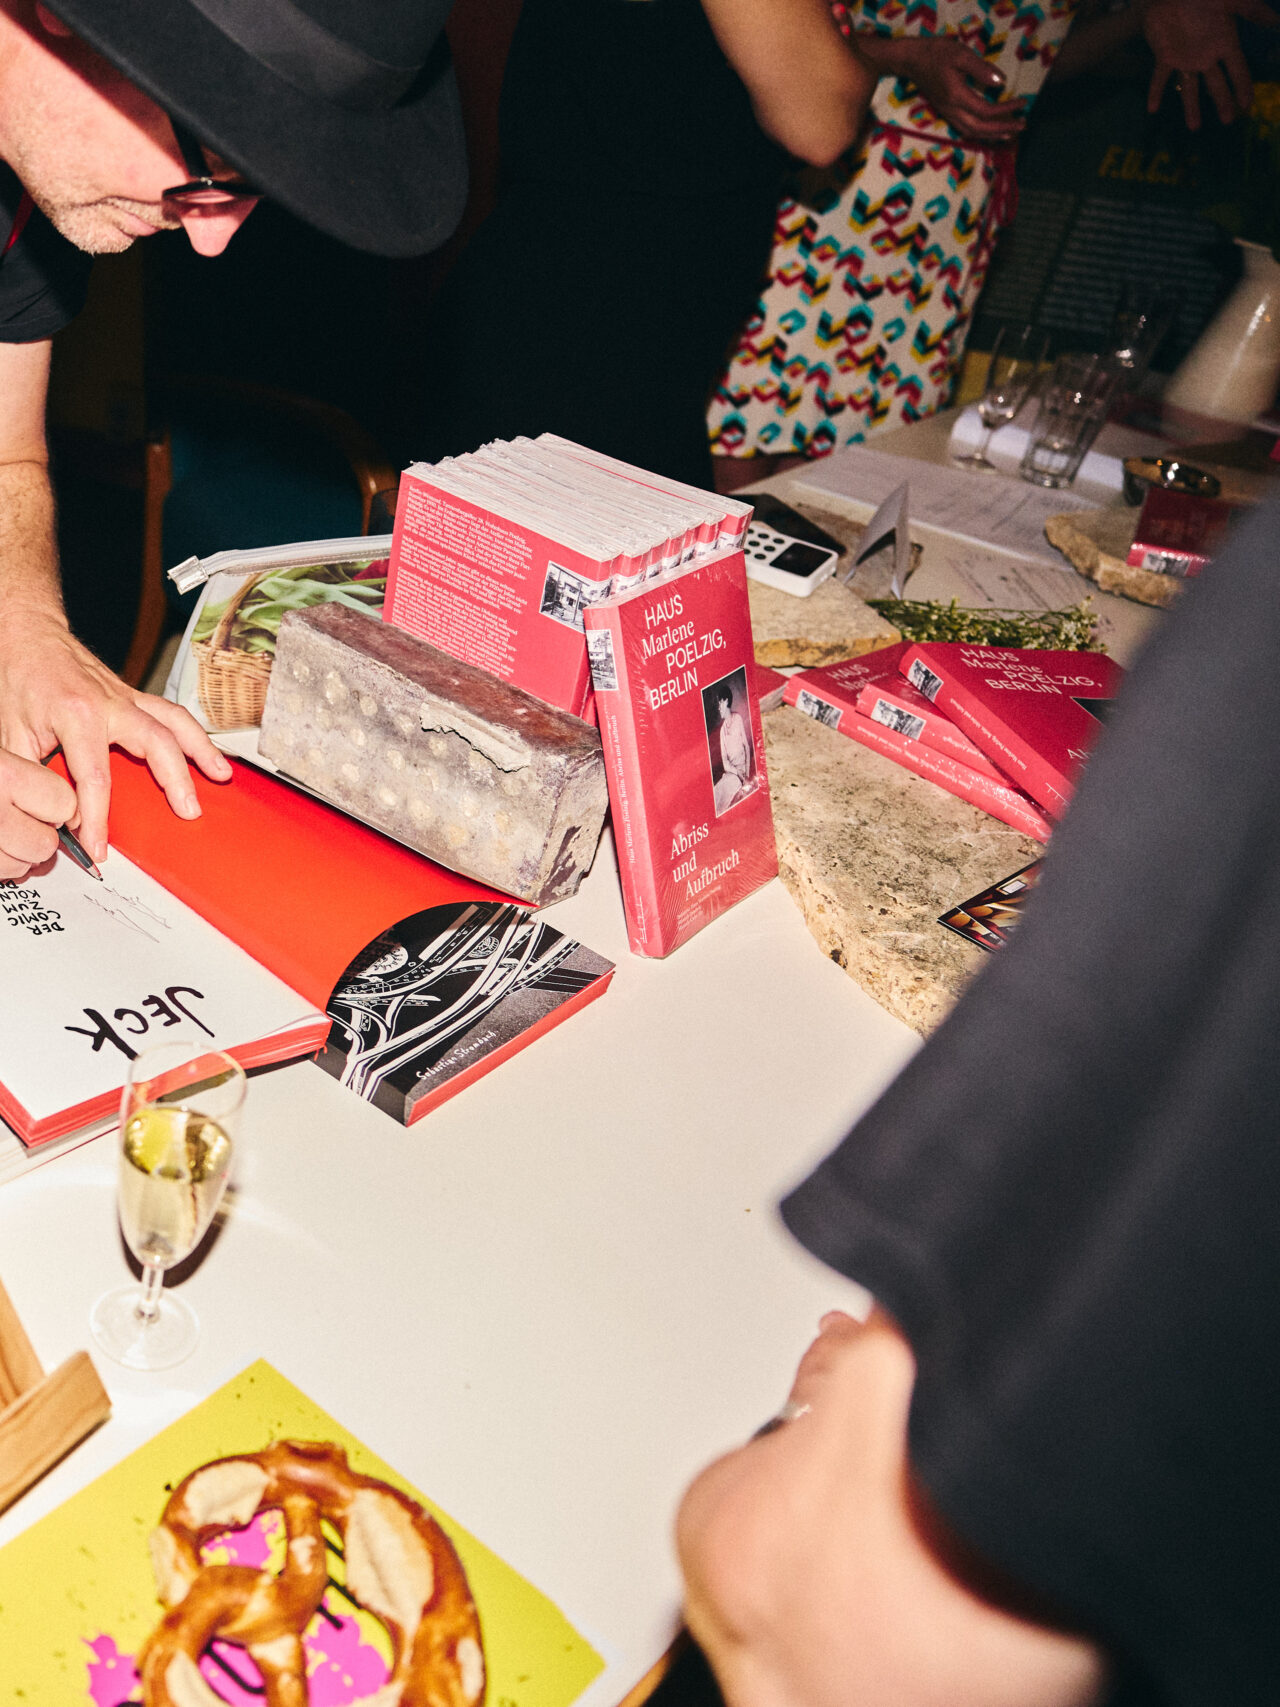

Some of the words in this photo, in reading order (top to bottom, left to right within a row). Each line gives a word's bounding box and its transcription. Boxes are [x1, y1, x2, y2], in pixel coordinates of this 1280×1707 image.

[645, 595, 683, 630] HAUS
[641, 621, 695, 661] Marlene
[666, 628, 727, 674] POELZIG,
[960, 648, 1019, 662] HAUS
[960, 657, 1044, 674] Marlene
[826, 664, 870, 682] HAUS
[1003, 671, 1103, 688] POELZIG,
[650, 673, 699, 711] BERLIN
[985, 678, 1063, 696] BERLIN
[670, 822, 709, 860] Abriss
[671, 857, 697, 883] und
[685, 850, 740, 901] Aufbruch
[2, 901, 44, 914] ZUM
[7, 910, 61, 926] COMIC
[26, 921, 65, 936] DER
[64, 986, 215, 1061] JECK
[415, 1055, 458, 1080] Sebastian
[453, 1030, 497, 1058] Strombach
